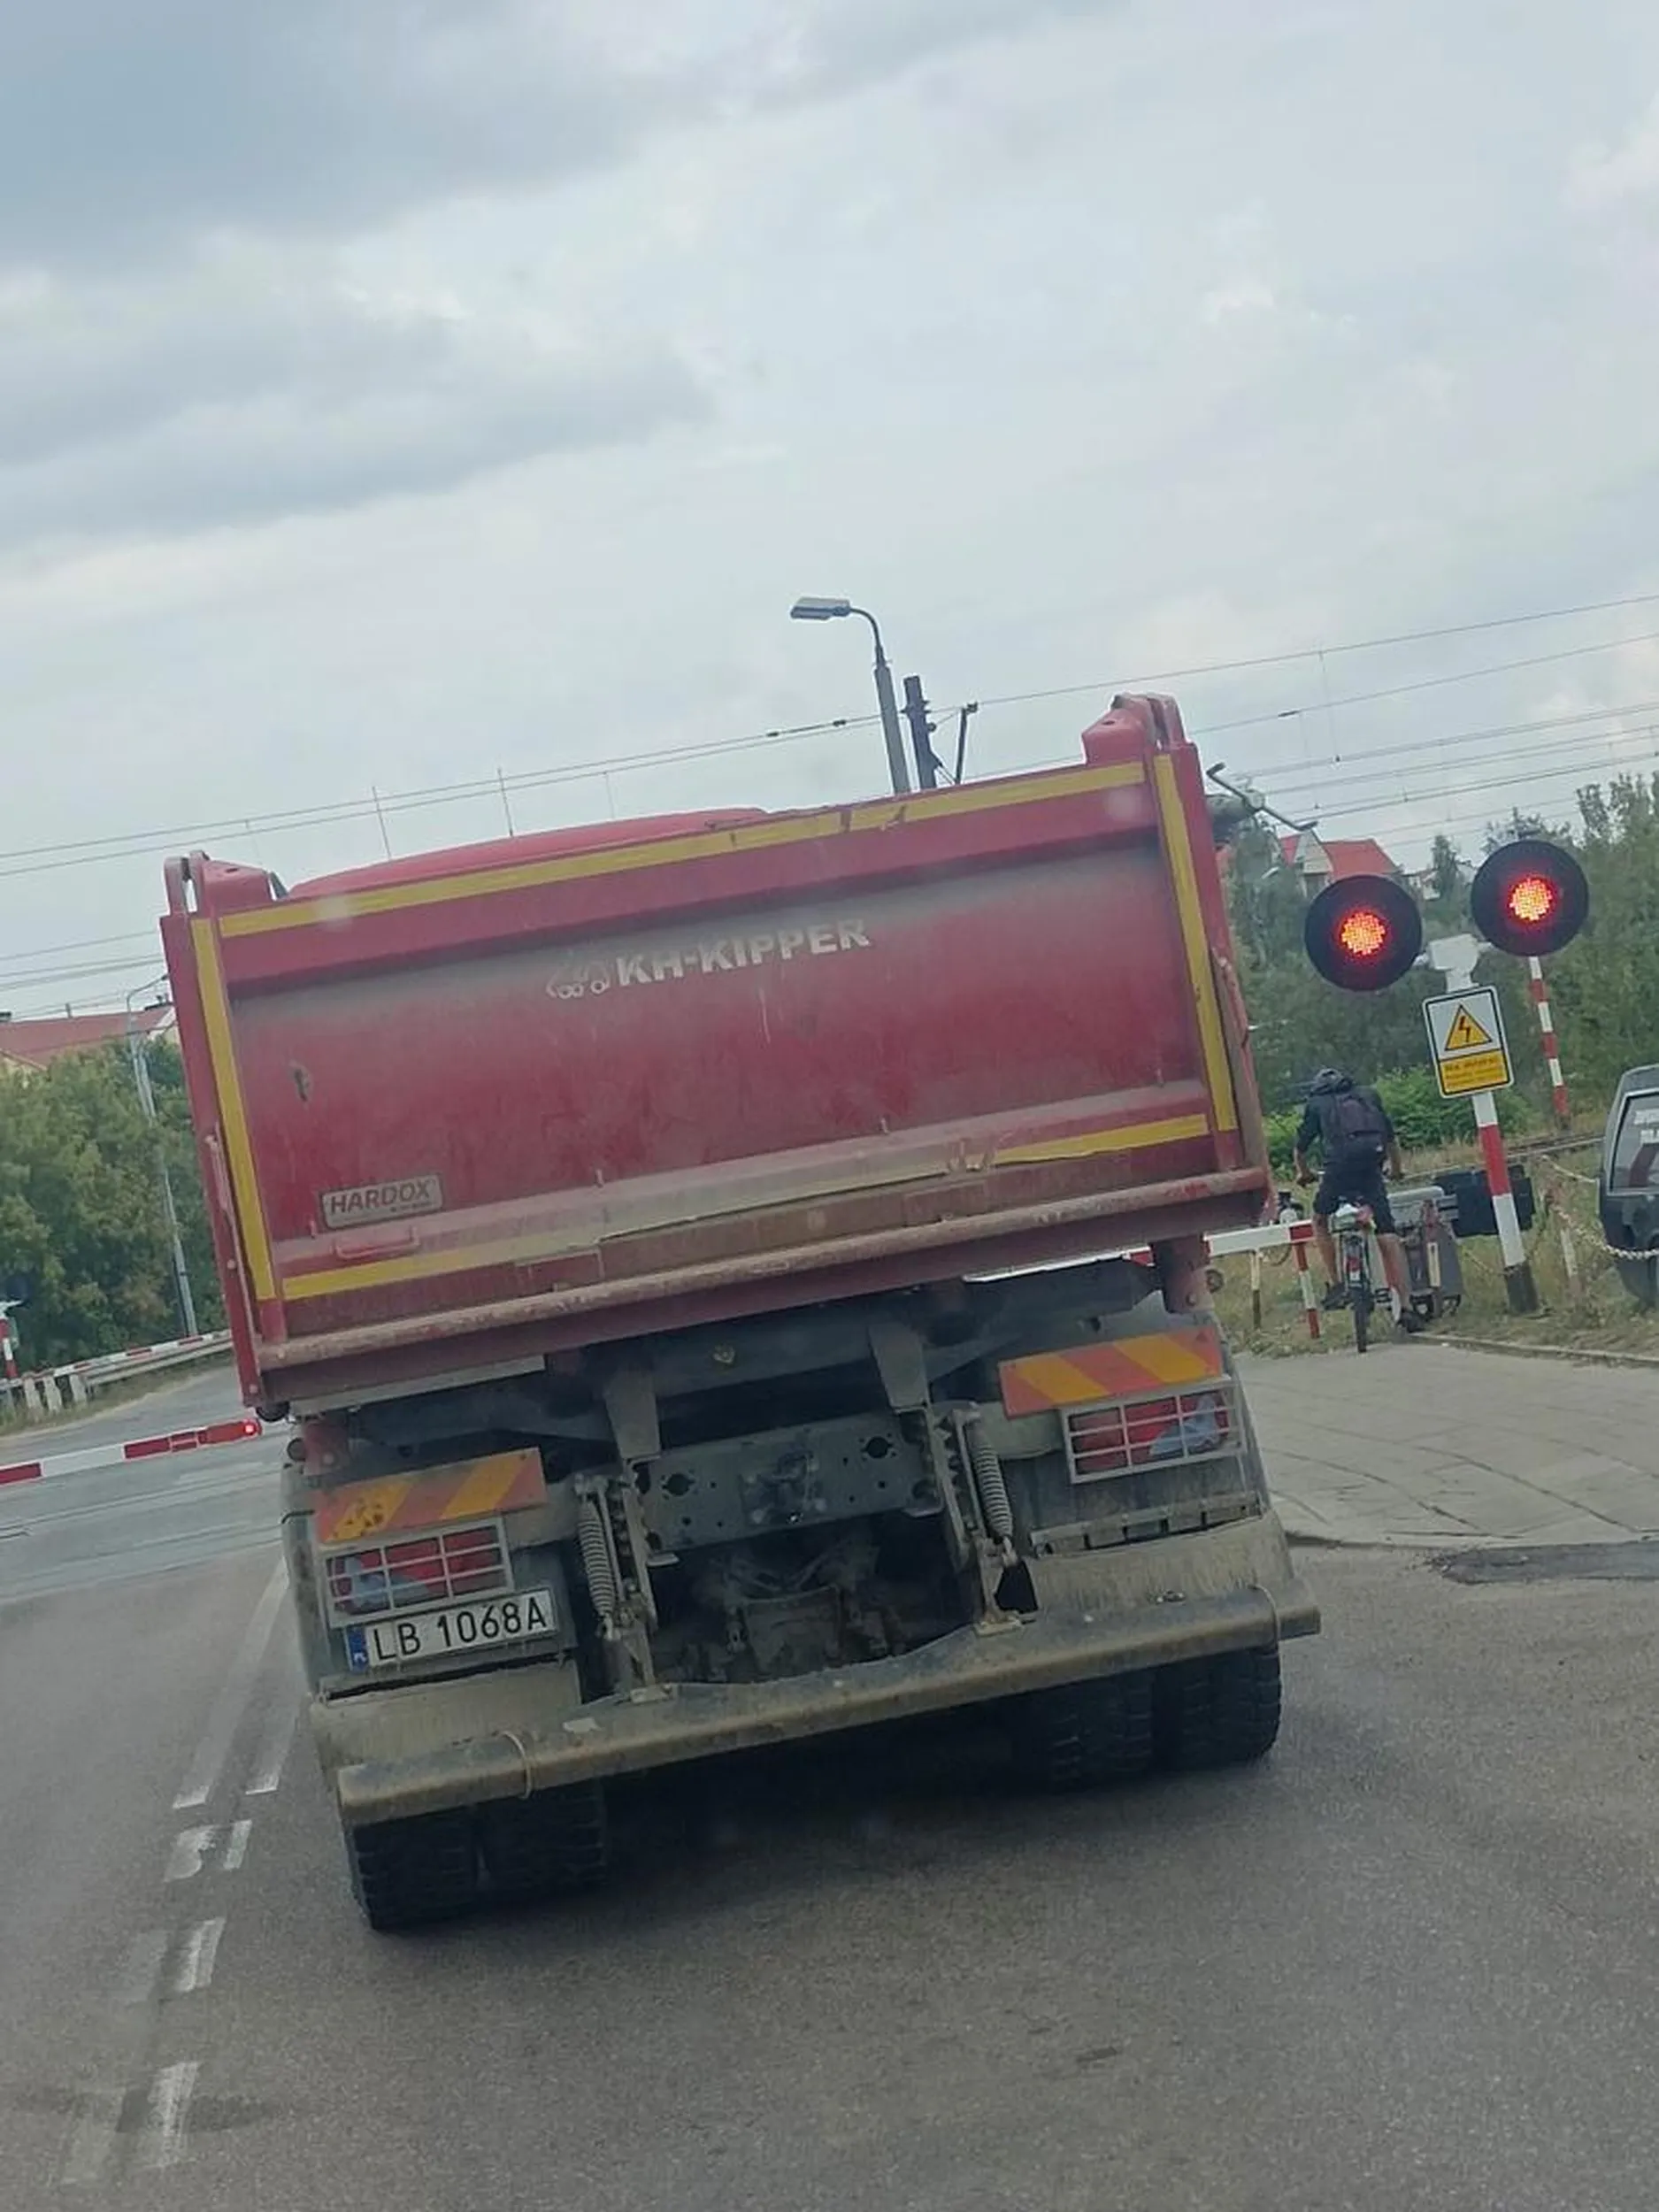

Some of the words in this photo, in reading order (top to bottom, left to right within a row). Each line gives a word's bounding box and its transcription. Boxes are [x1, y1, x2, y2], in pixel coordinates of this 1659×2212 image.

[618, 918, 871, 987] KH-KIPPER
[330, 1181, 430, 1215] HARDOX
[373, 1623, 421, 1661] LB
[437, 1596, 547, 1647] 1068A
